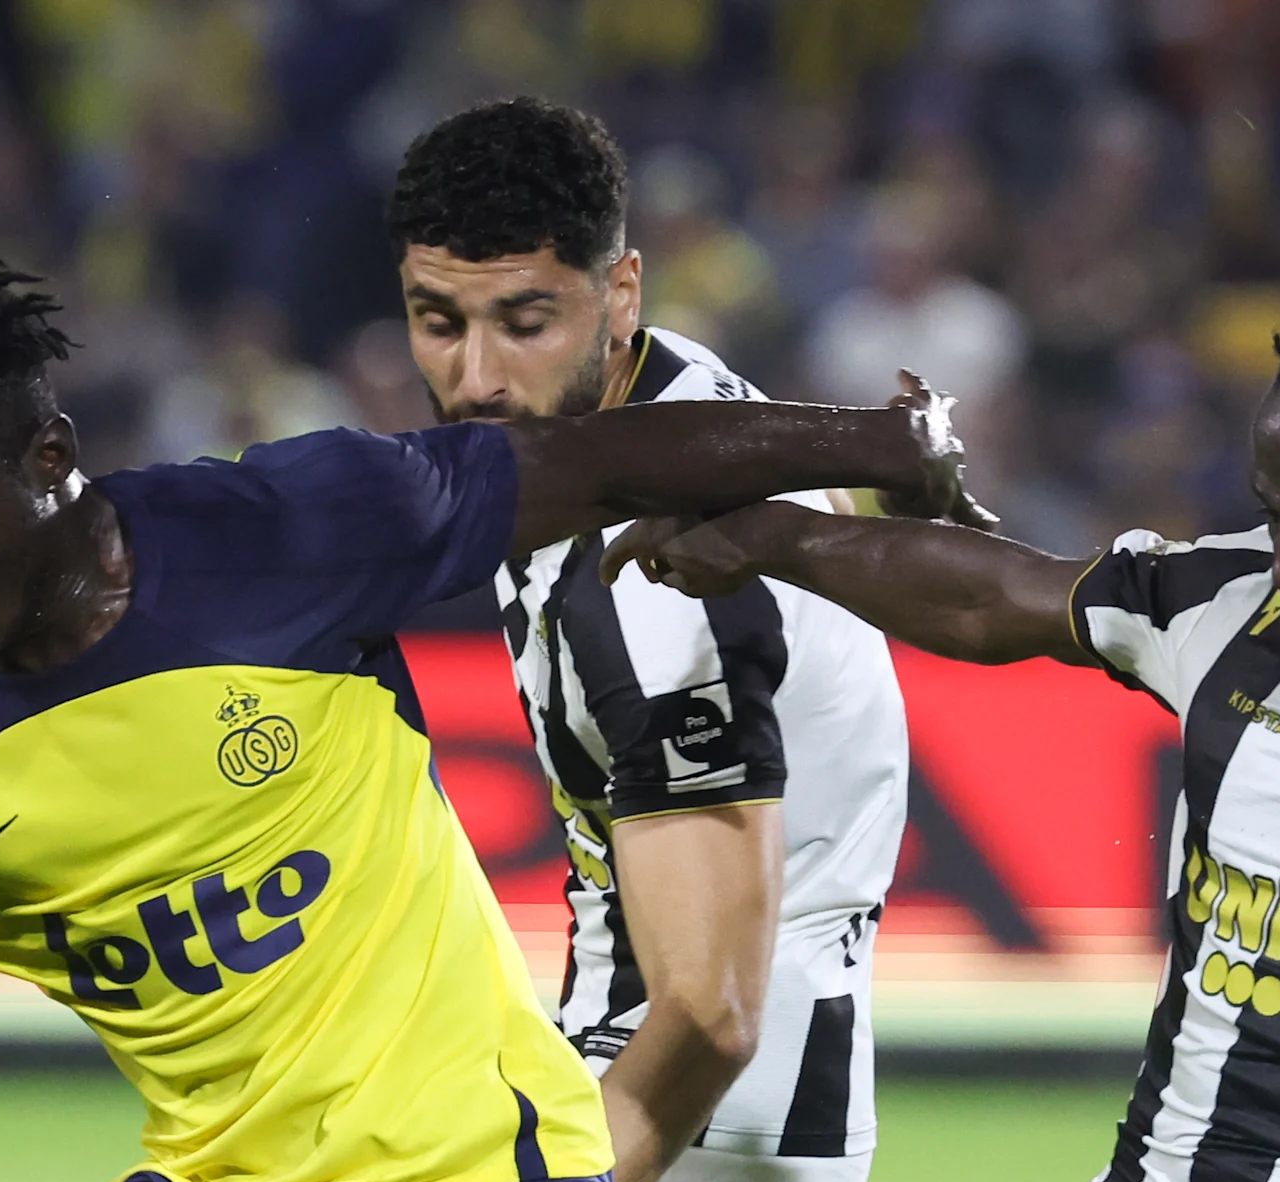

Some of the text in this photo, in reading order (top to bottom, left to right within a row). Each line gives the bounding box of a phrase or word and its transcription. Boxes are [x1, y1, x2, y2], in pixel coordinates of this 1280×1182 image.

[684, 715, 708, 730] Pro
[676, 727, 722, 748] League
[224, 725, 292, 777] USG
